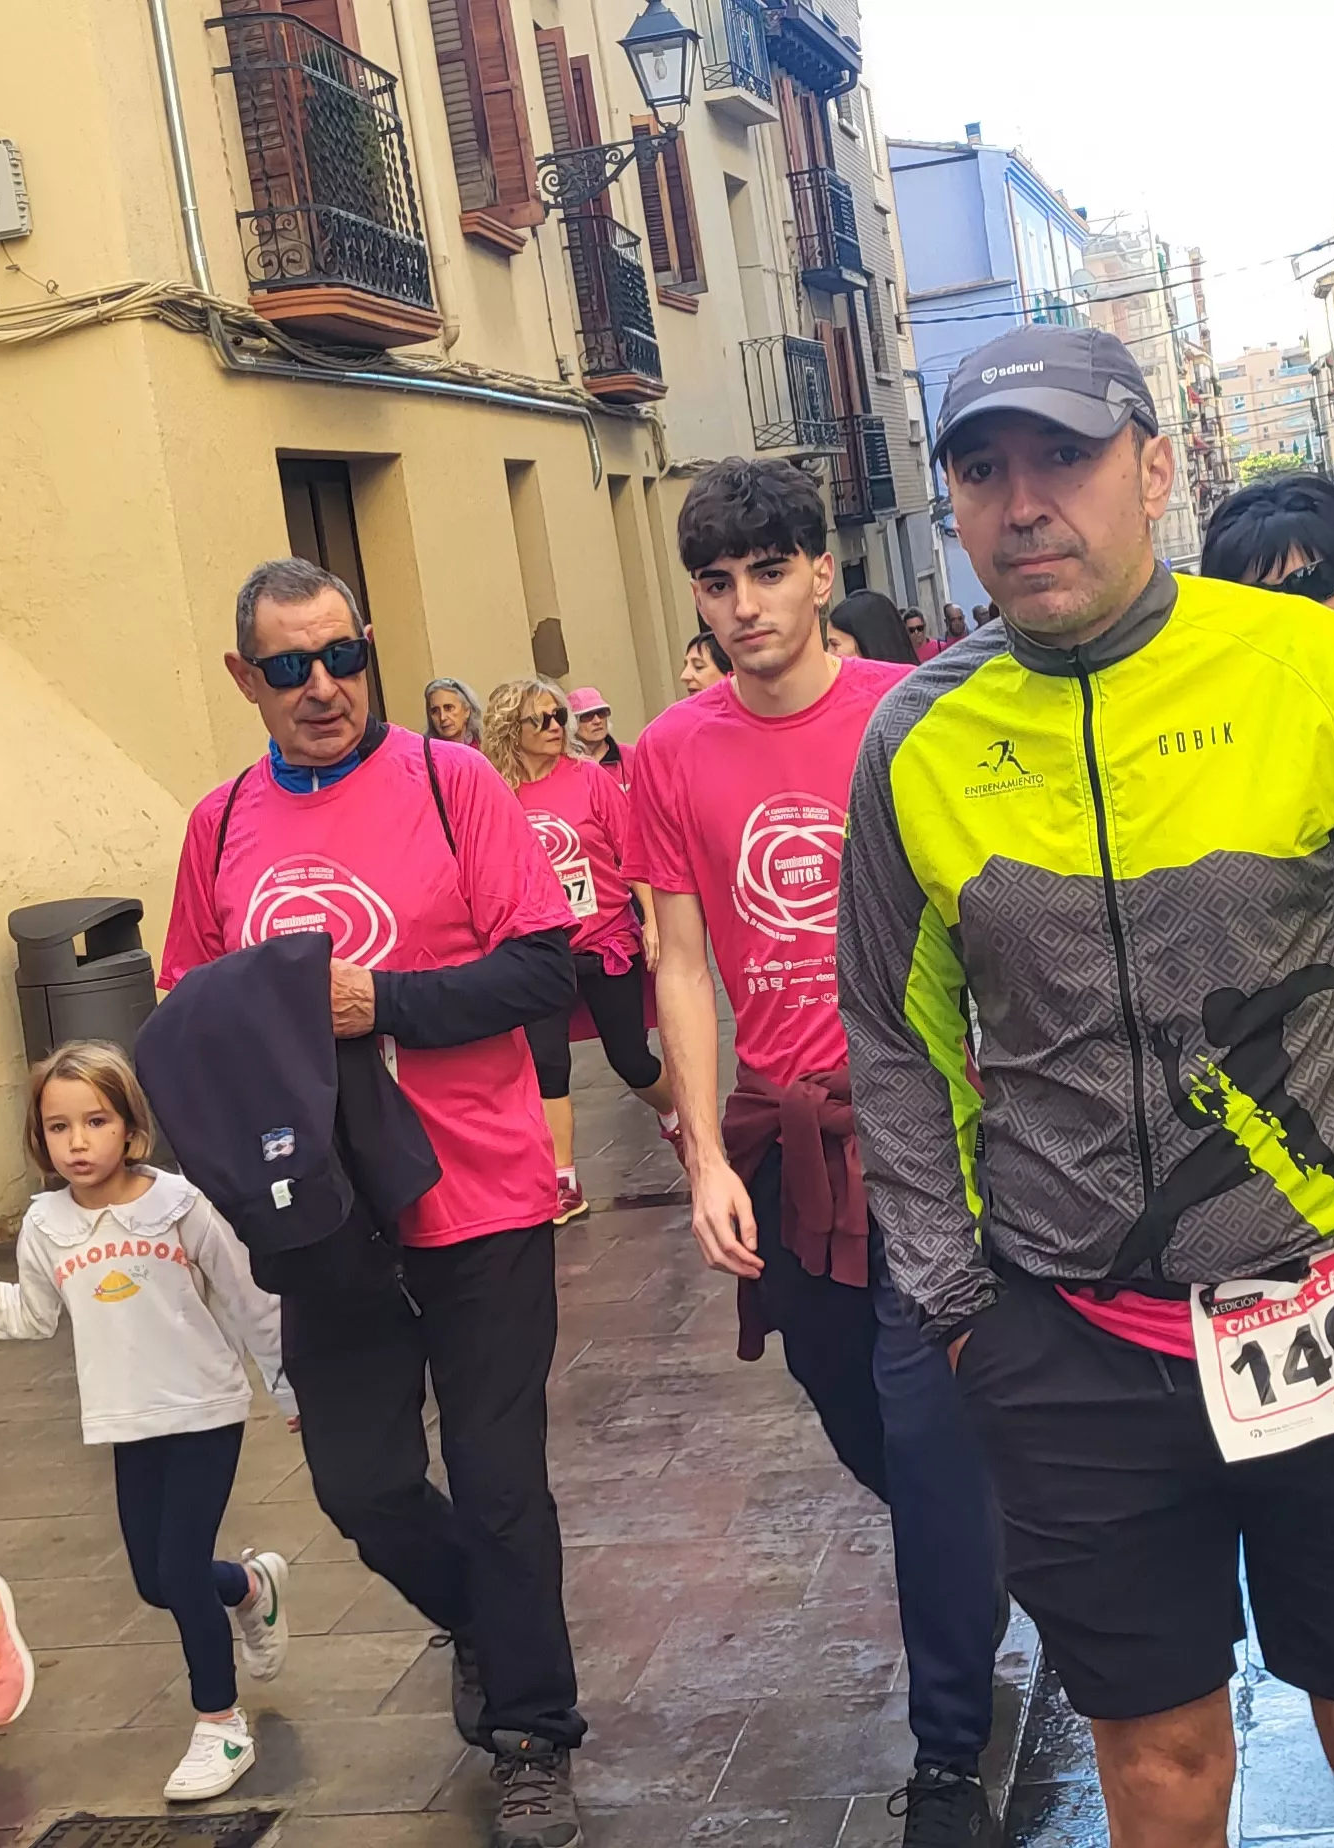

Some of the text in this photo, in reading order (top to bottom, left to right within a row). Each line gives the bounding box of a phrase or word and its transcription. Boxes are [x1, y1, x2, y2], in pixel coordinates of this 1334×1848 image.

[1158, 721, 1234, 756] GOBIK
[964, 773, 1044, 795] ENTRENAMIENTO
[273, 912, 327, 930] Caminemos
[1210, 1296, 1259, 1317] X EDICIÓN
